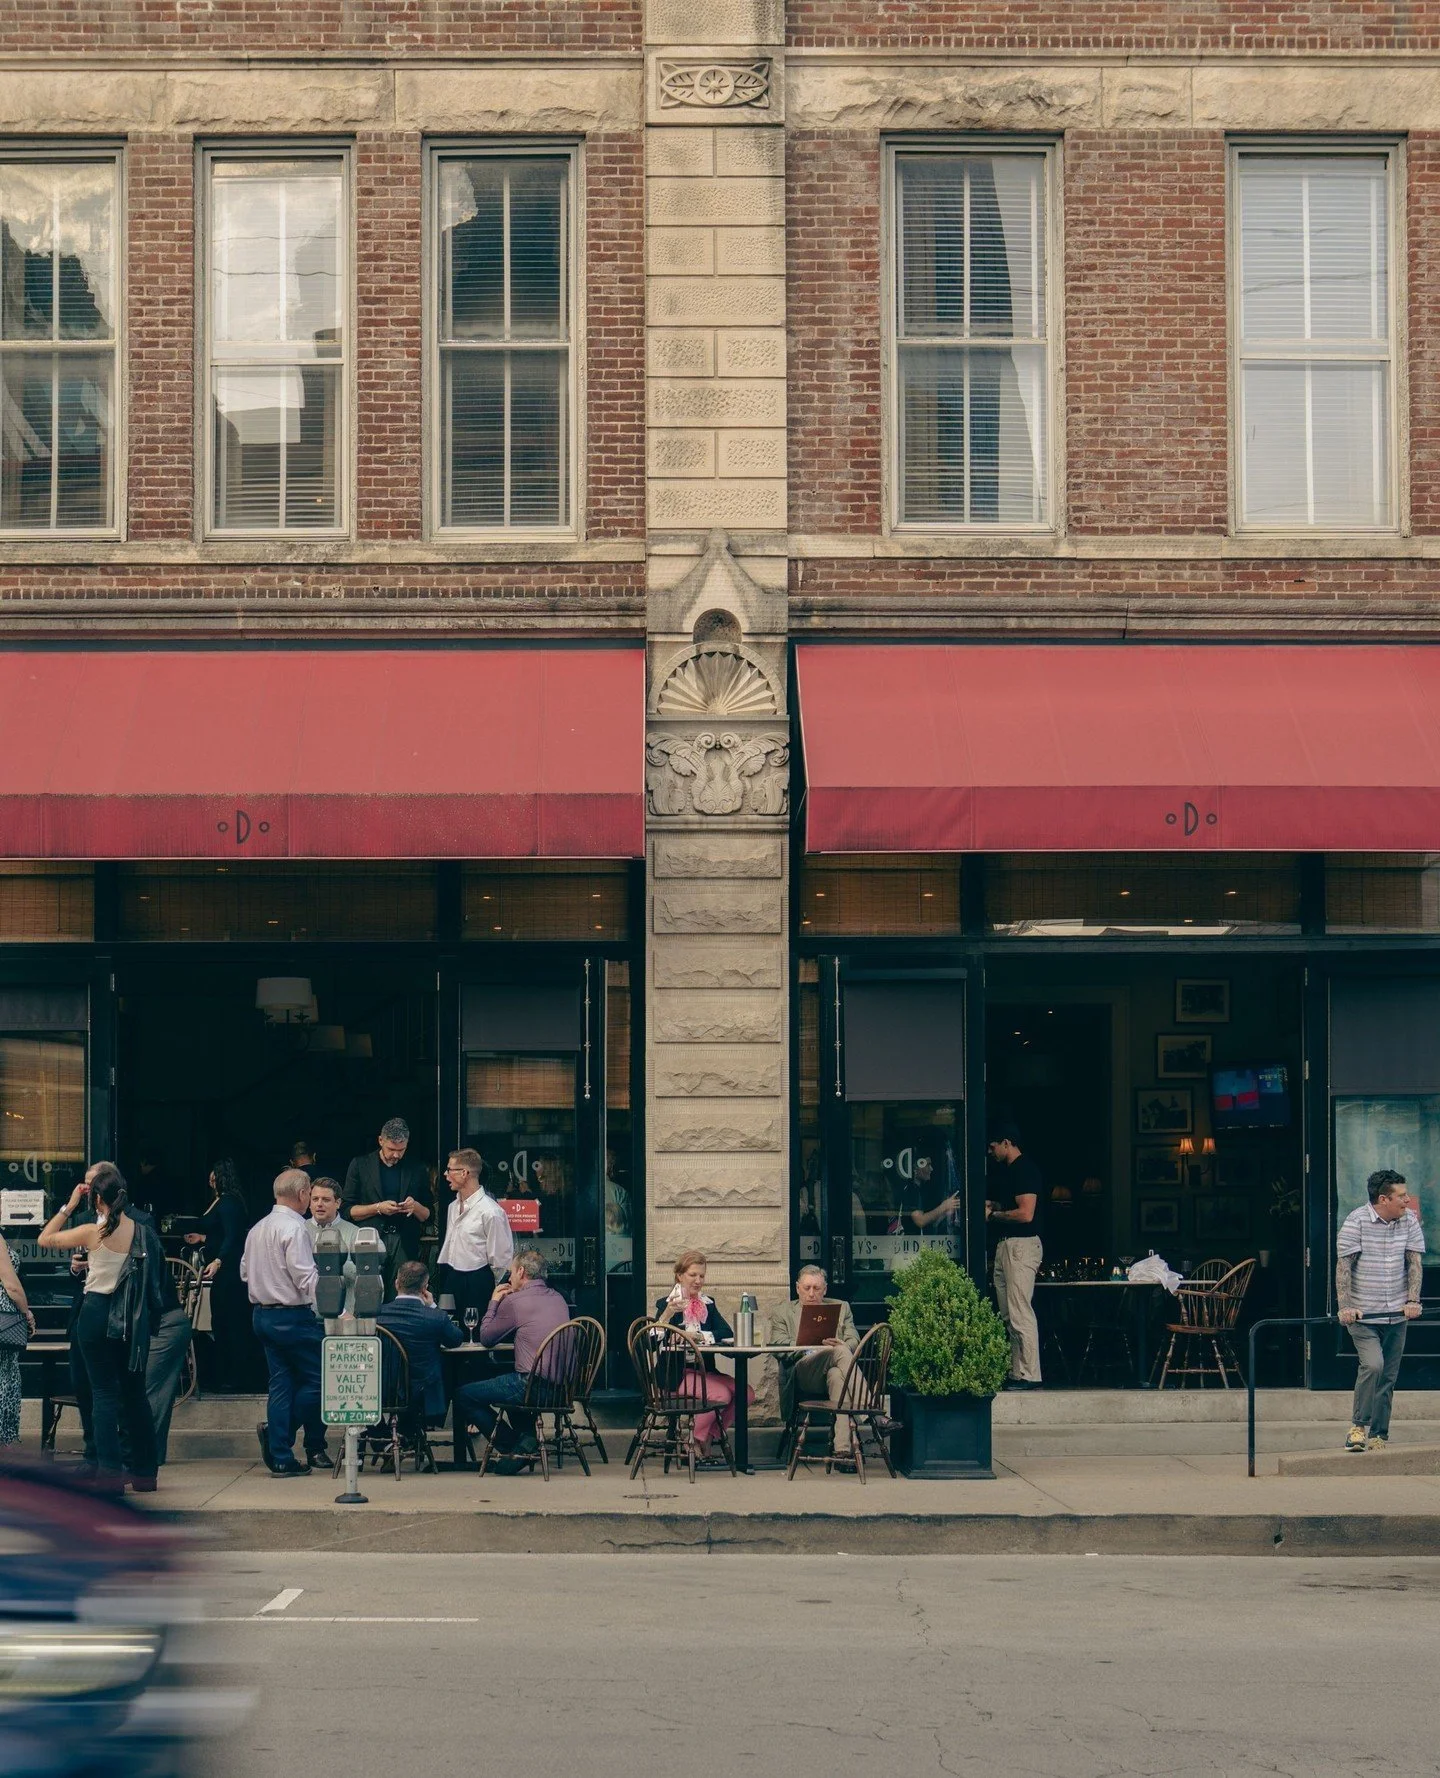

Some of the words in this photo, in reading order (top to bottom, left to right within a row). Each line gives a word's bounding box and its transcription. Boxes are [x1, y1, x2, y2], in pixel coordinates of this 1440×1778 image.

[330, 1353, 374, 1362] PARKING
[336, 1374, 368, 1383] VALET
[337, 1384, 366, 1394] ONLY
